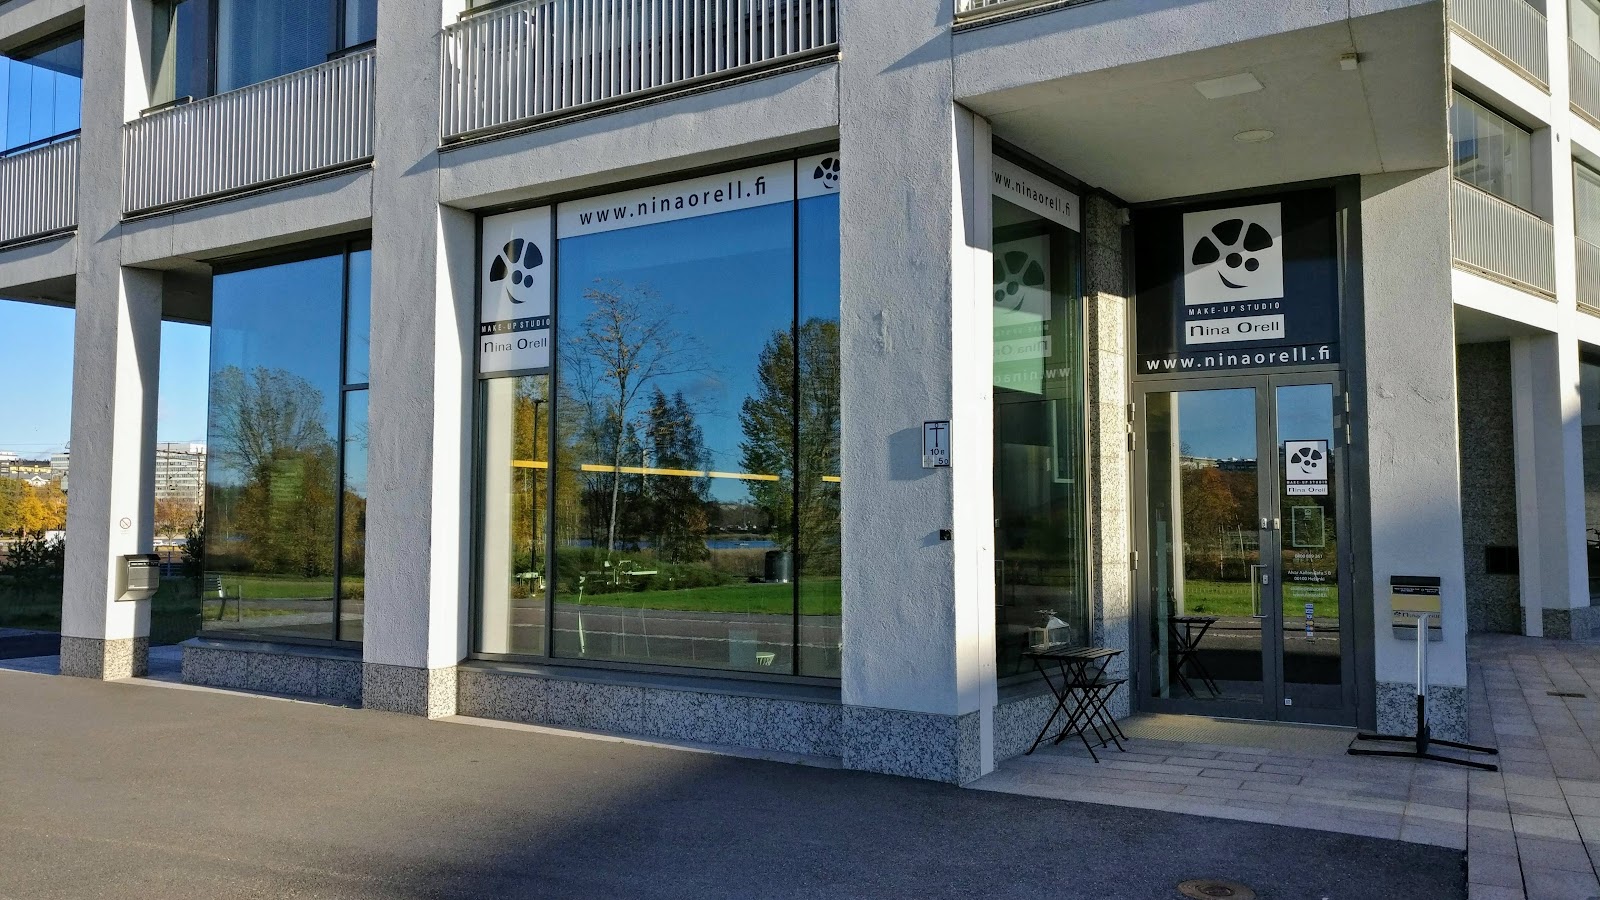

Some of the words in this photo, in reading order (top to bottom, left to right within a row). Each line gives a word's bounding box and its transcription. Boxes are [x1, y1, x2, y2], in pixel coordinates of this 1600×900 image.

[992, 170, 1071, 216] ww.ninaorell.fi
[579, 176, 767, 226] www.ninaorell.fi
[1188, 305, 1236, 316] MAKE-UP
[1240, 301, 1280, 312] STUDIO
[481, 323, 517, 333] MAKE-UP
[520, 318, 551, 329] STUDIO
[1237, 321, 1279, 333] Orell
[517, 338, 547, 350] Orell
[1146, 345, 1330, 370] www.ninaorell.fi
